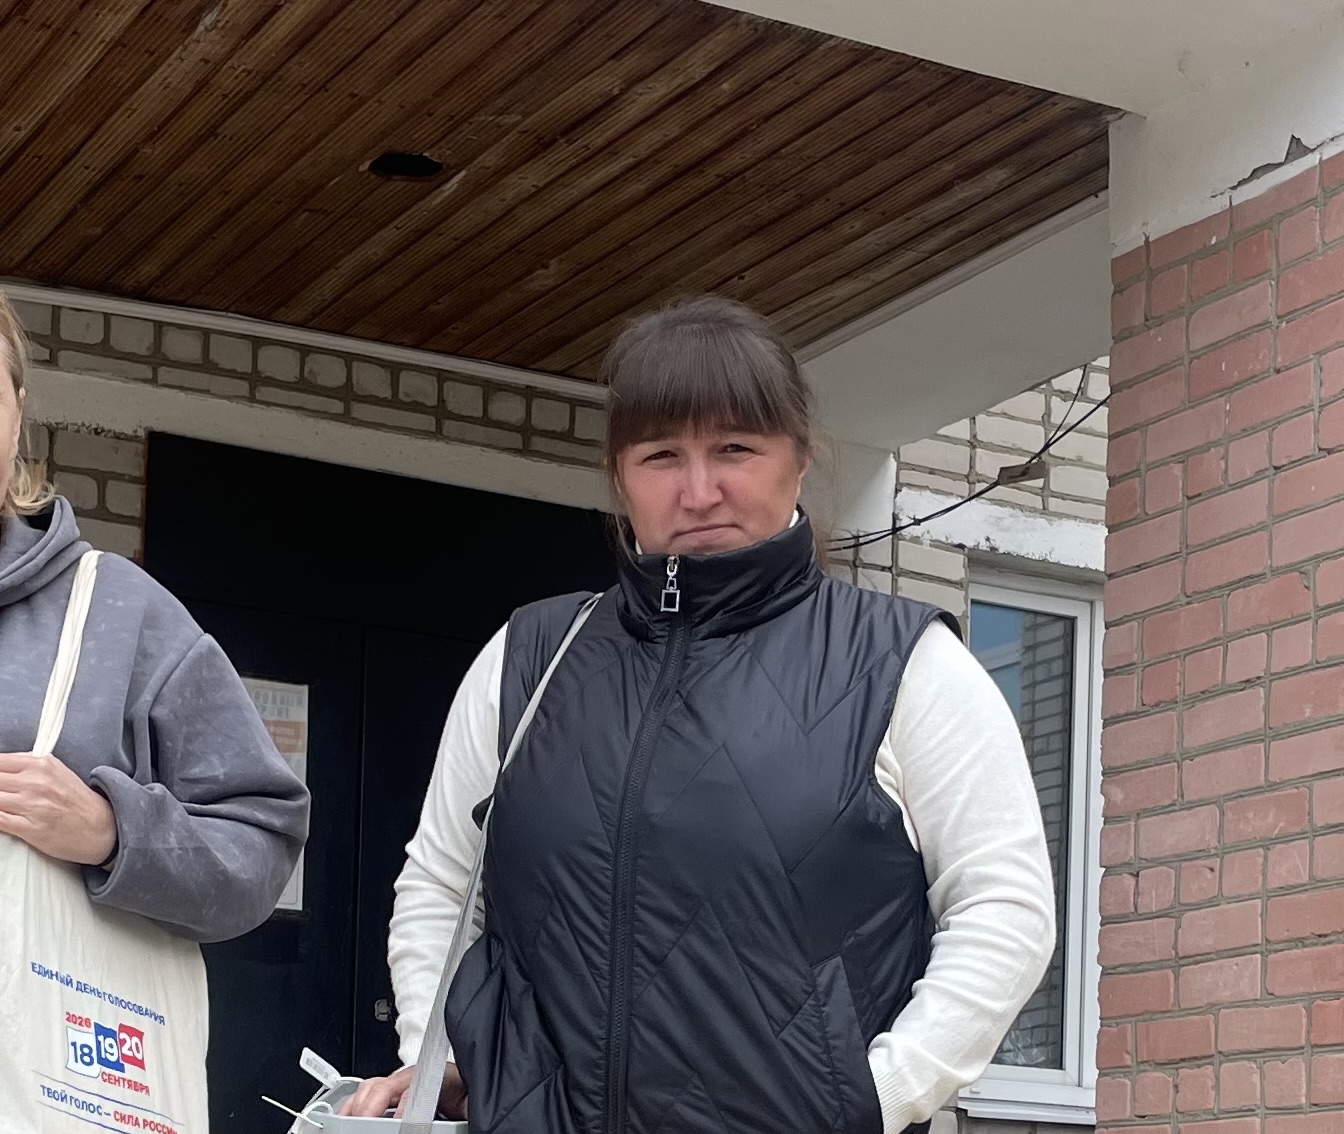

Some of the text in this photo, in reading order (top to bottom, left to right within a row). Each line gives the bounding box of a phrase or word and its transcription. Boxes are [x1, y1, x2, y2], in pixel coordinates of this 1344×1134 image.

[31, 961, 166, 1026] ЕДИНЫЙ ДЕНЬ ГОЛОСОВАНИЯ
[70, 1032, 143, 1066] 18 19 20
[101, 1071, 151, 1096] СЕНТЯБРЯ
[40, 1084, 69, 1103] ТВОЙ
[70, 1095, 103, 1117] ГОЛОС
[113, 1110, 141, 1129] СИЛА
